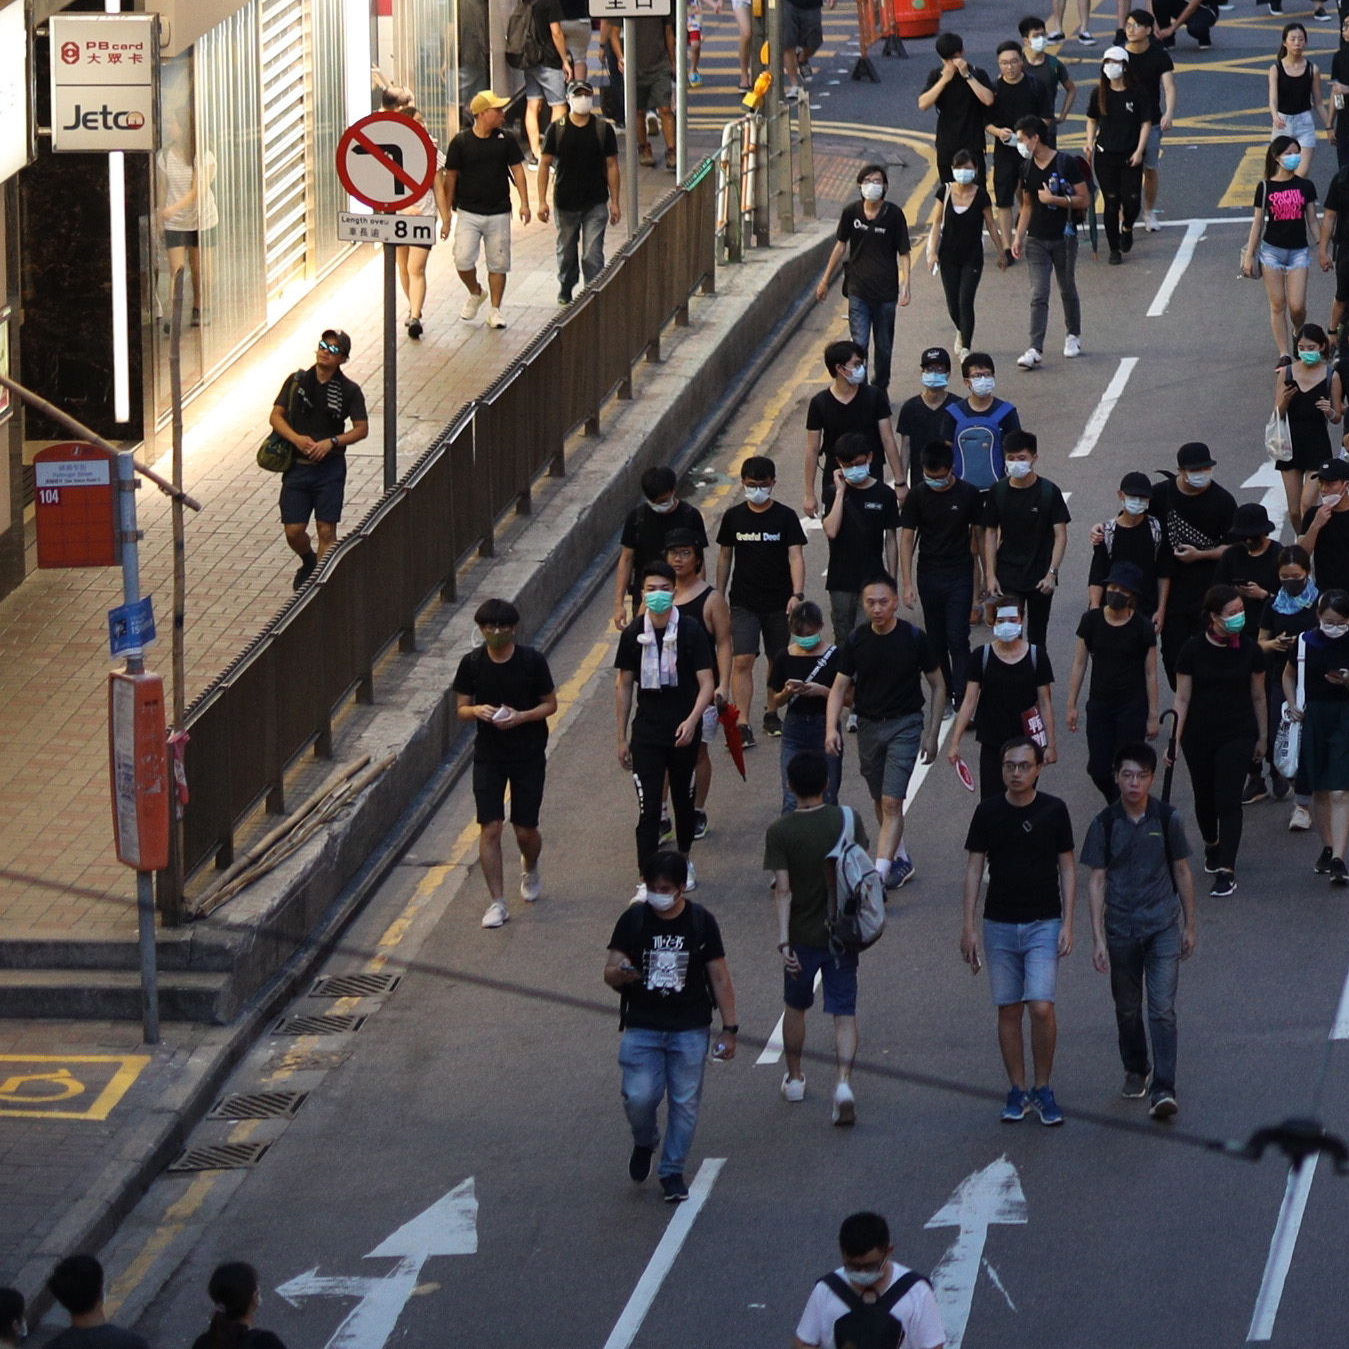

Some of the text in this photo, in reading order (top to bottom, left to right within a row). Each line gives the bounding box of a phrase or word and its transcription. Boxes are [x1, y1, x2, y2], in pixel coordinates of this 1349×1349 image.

[86, 41, 144, 50] PB card
[341, 215, 368, 225] Length
[394, 220, 431, 239] 8 m
[39, 488, 60, 504] 104
